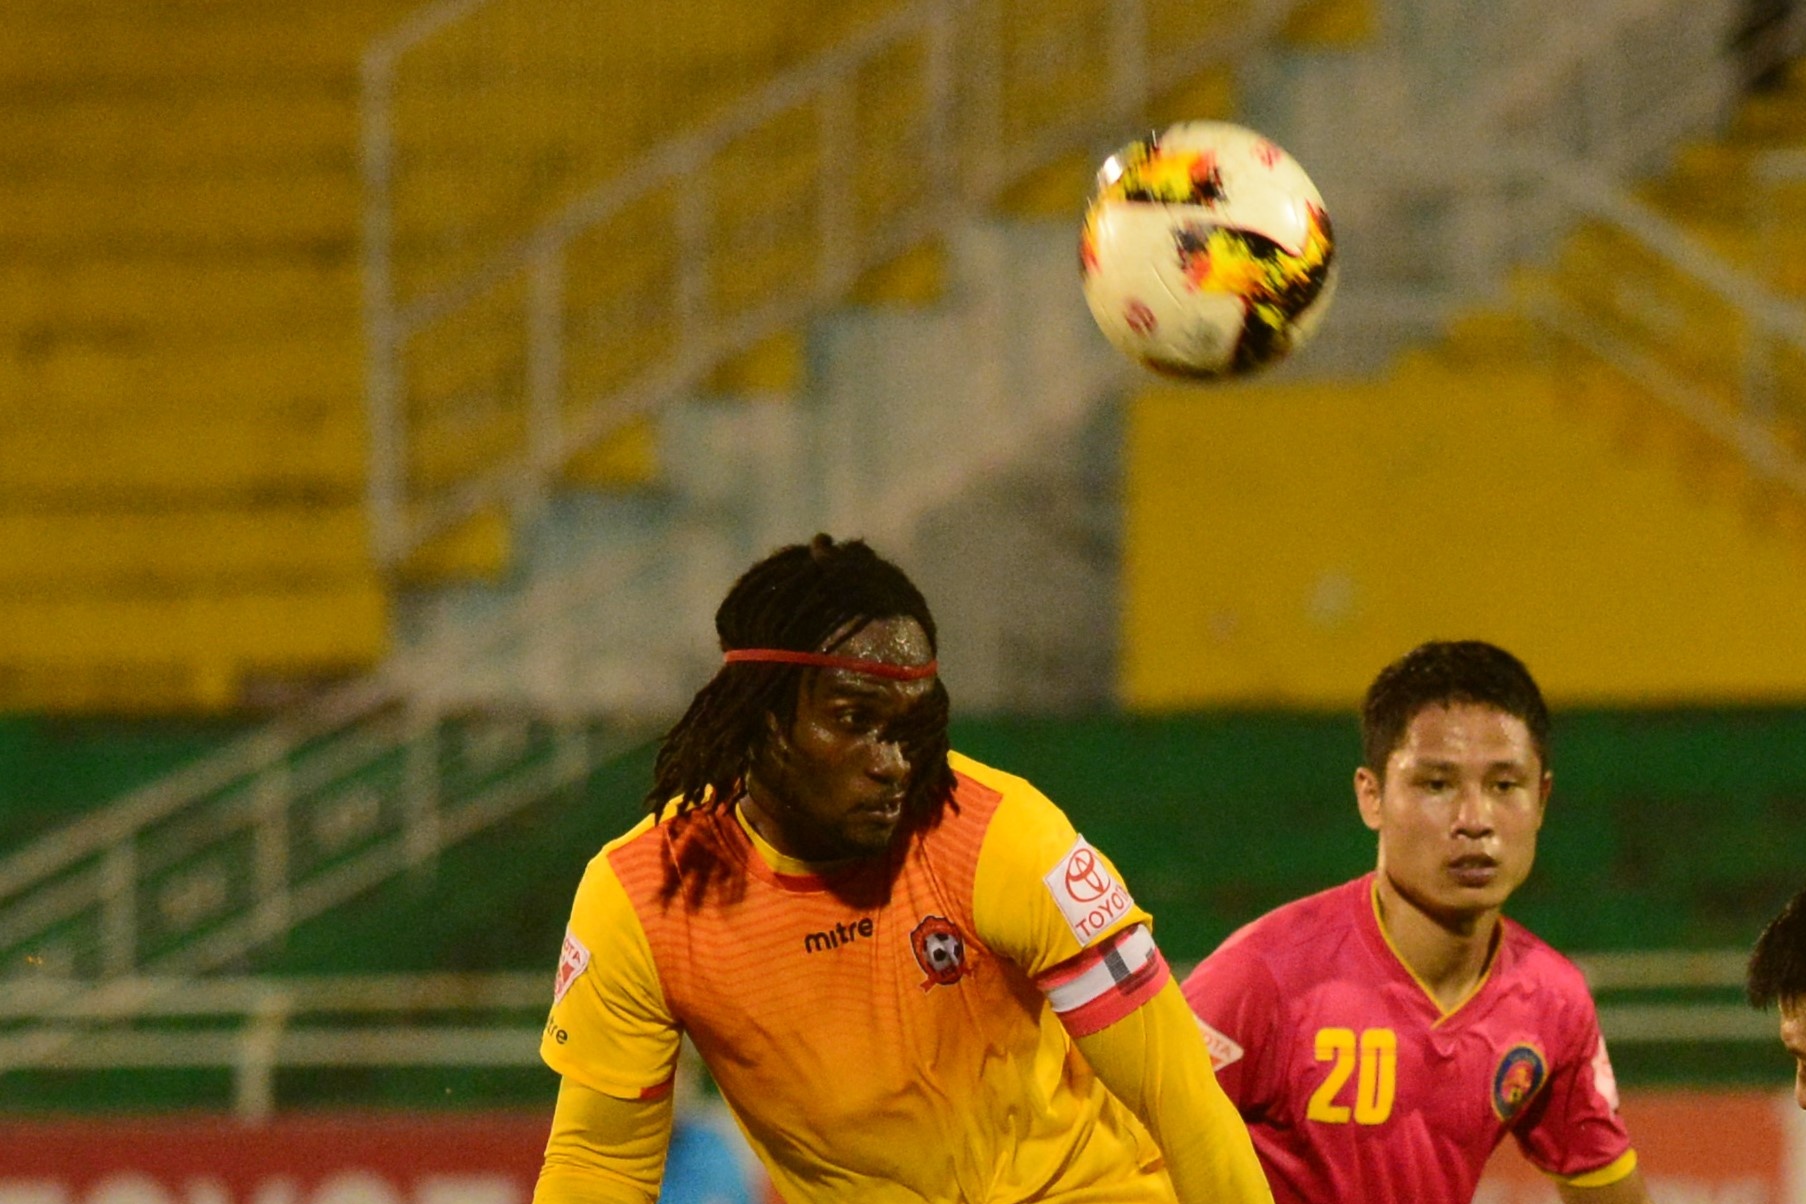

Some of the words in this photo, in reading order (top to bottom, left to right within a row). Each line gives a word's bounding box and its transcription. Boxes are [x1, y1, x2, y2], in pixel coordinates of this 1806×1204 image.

[804, 917, 874, 953] mitre
[1075, 884, 1130, 937] TOYO
[1306, 1027, 1398, 1126] 20
